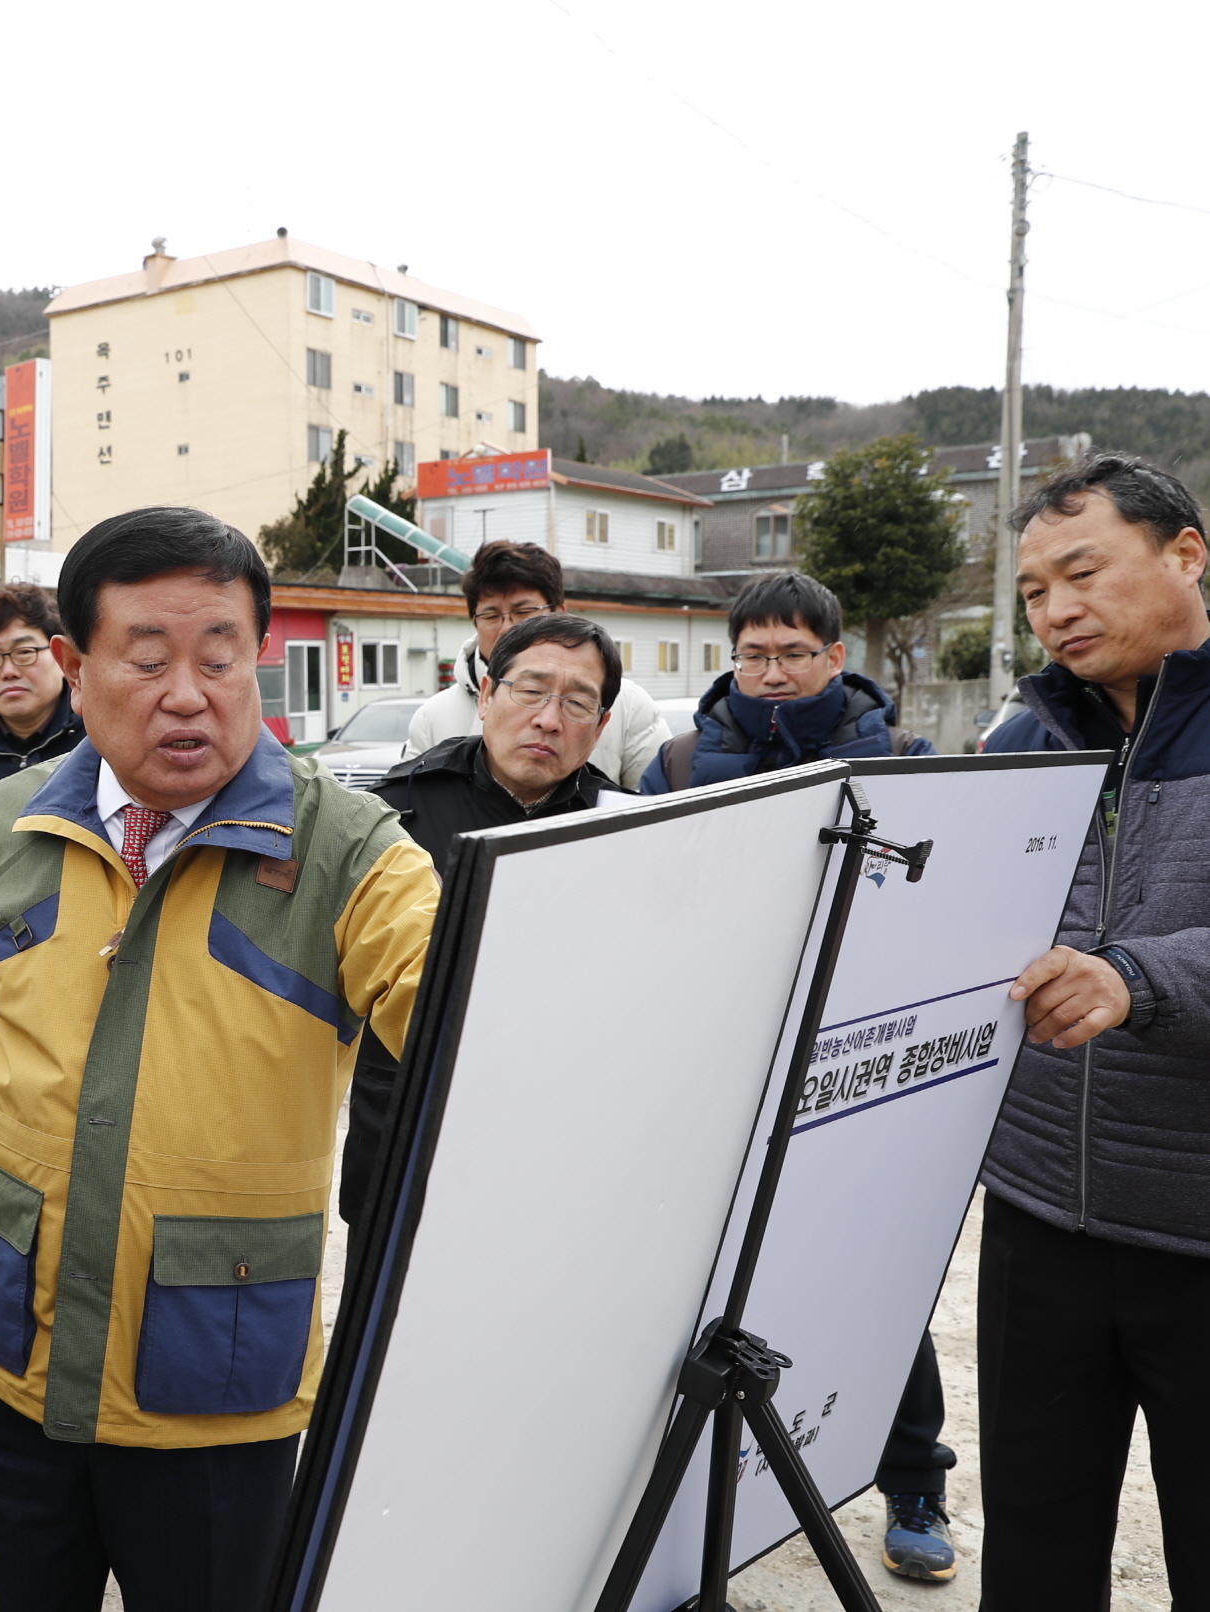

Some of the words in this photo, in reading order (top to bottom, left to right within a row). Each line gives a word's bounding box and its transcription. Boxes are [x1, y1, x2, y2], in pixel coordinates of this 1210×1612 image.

[164, 347, 192, 364] 101
[96, 341, 112, 465] 옥주맨션
[9, 418, 31, 514] 노벨학원
[446, 458, 548, 487] 노벨학원
[1025, 836, 1045, 853] 2016.
[1047, 834, 1058, 850] 11.
[810, 1014, 919, 1064] 일반농산어촌개발사업
[795, 1051, 895, 1116] 오일시권역
[896, 1020, 999, 1085] 종합정비사업
